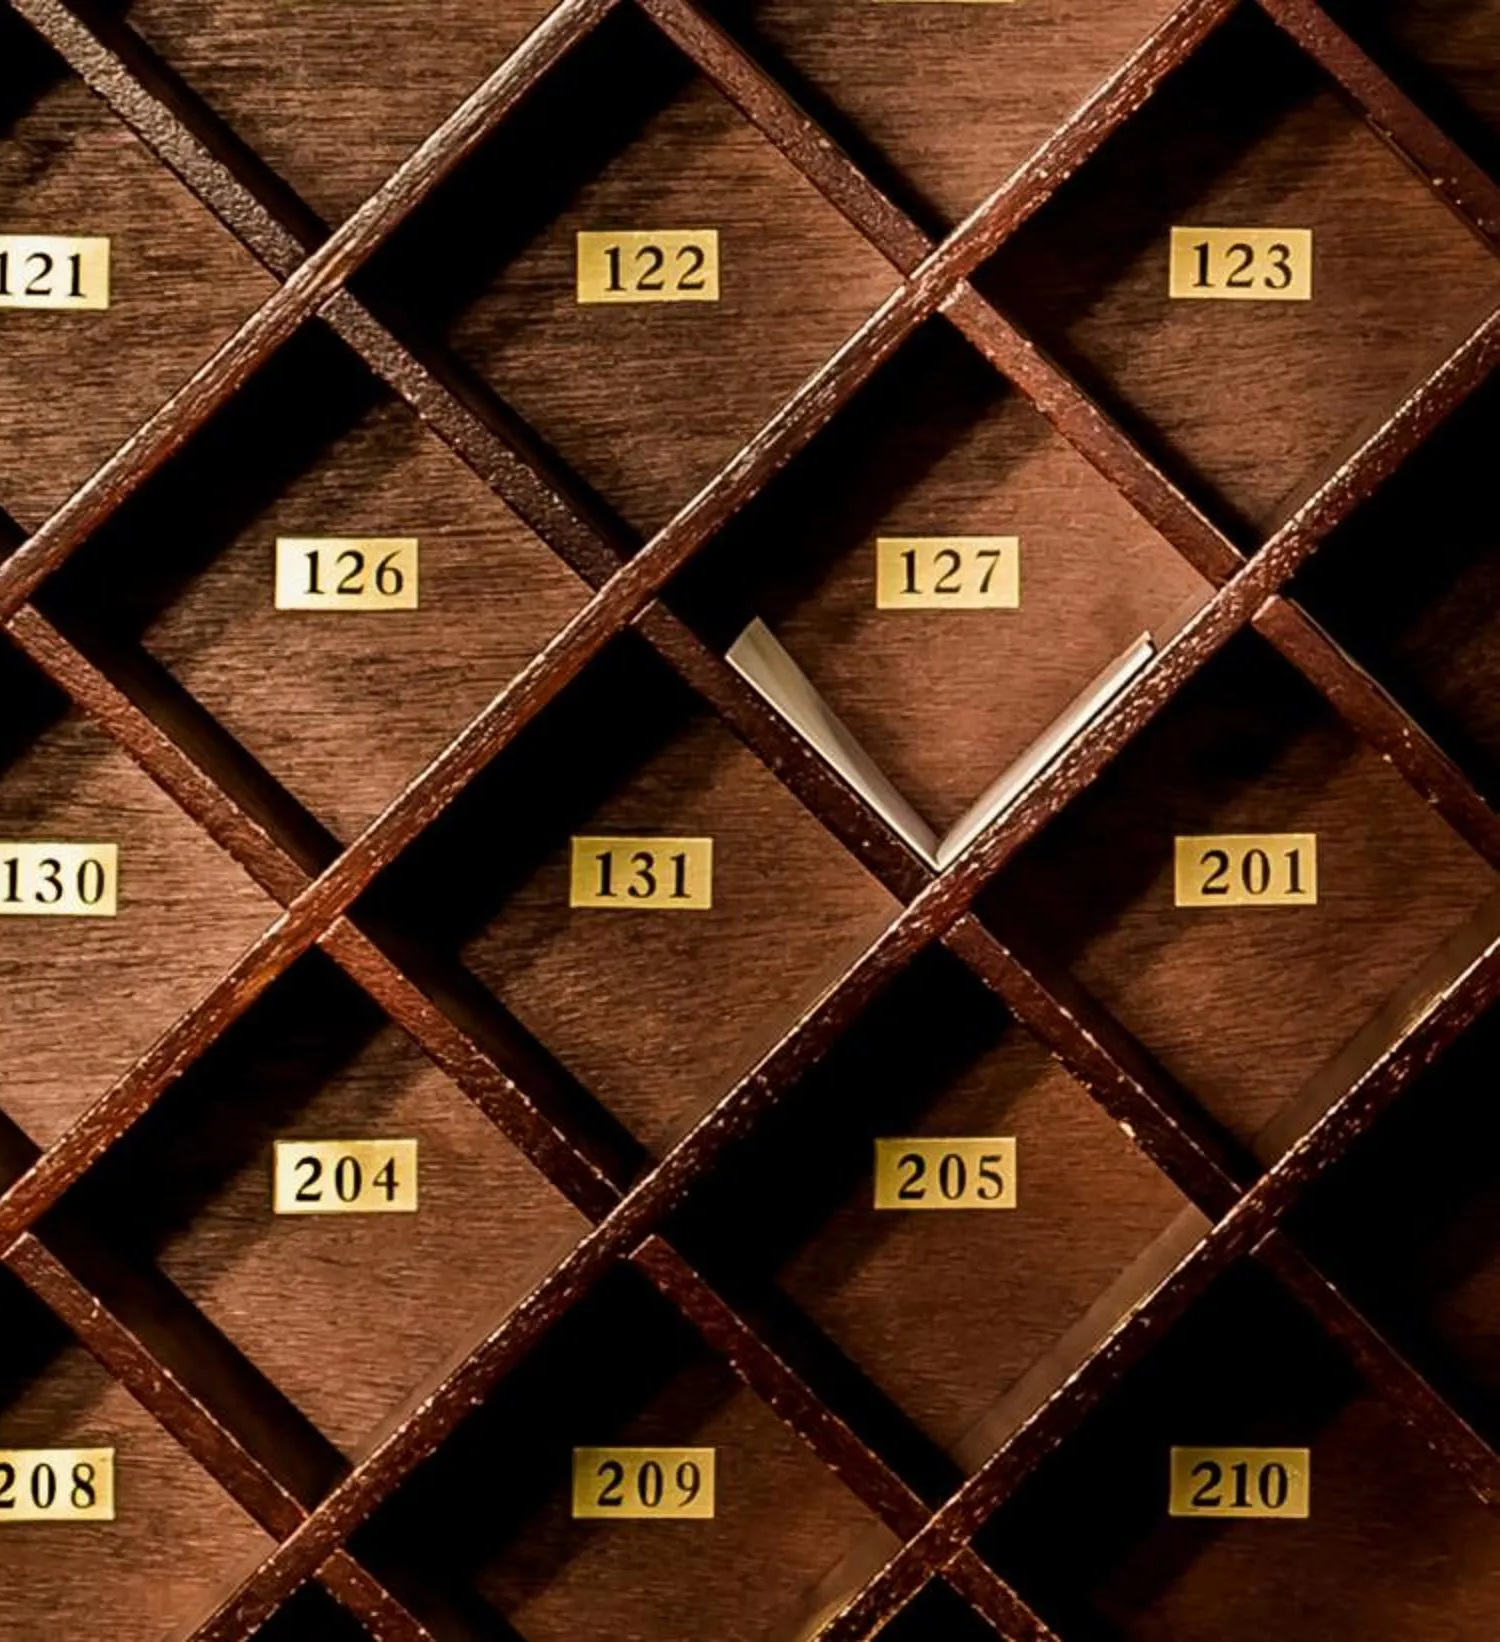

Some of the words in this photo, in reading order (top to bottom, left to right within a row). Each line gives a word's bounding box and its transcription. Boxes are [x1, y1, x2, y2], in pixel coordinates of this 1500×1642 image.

[605, 246, 704, 291] 122
[1194, 242, 1292, 288] 123
[307, 550, 403, 596] 126
[900, 549, 999, 594] 127
[4, 858, 104, 903] 130
[596, 851, 689, 898] 131
[1200, 849, 1304, 895] 201
[295, 1156, 399, 1202] 204
[897, 1153, 1002, 1200] 205
[597, 1459, 700, 1507] 209
[1190, 1462, 1287, 1508] 210
